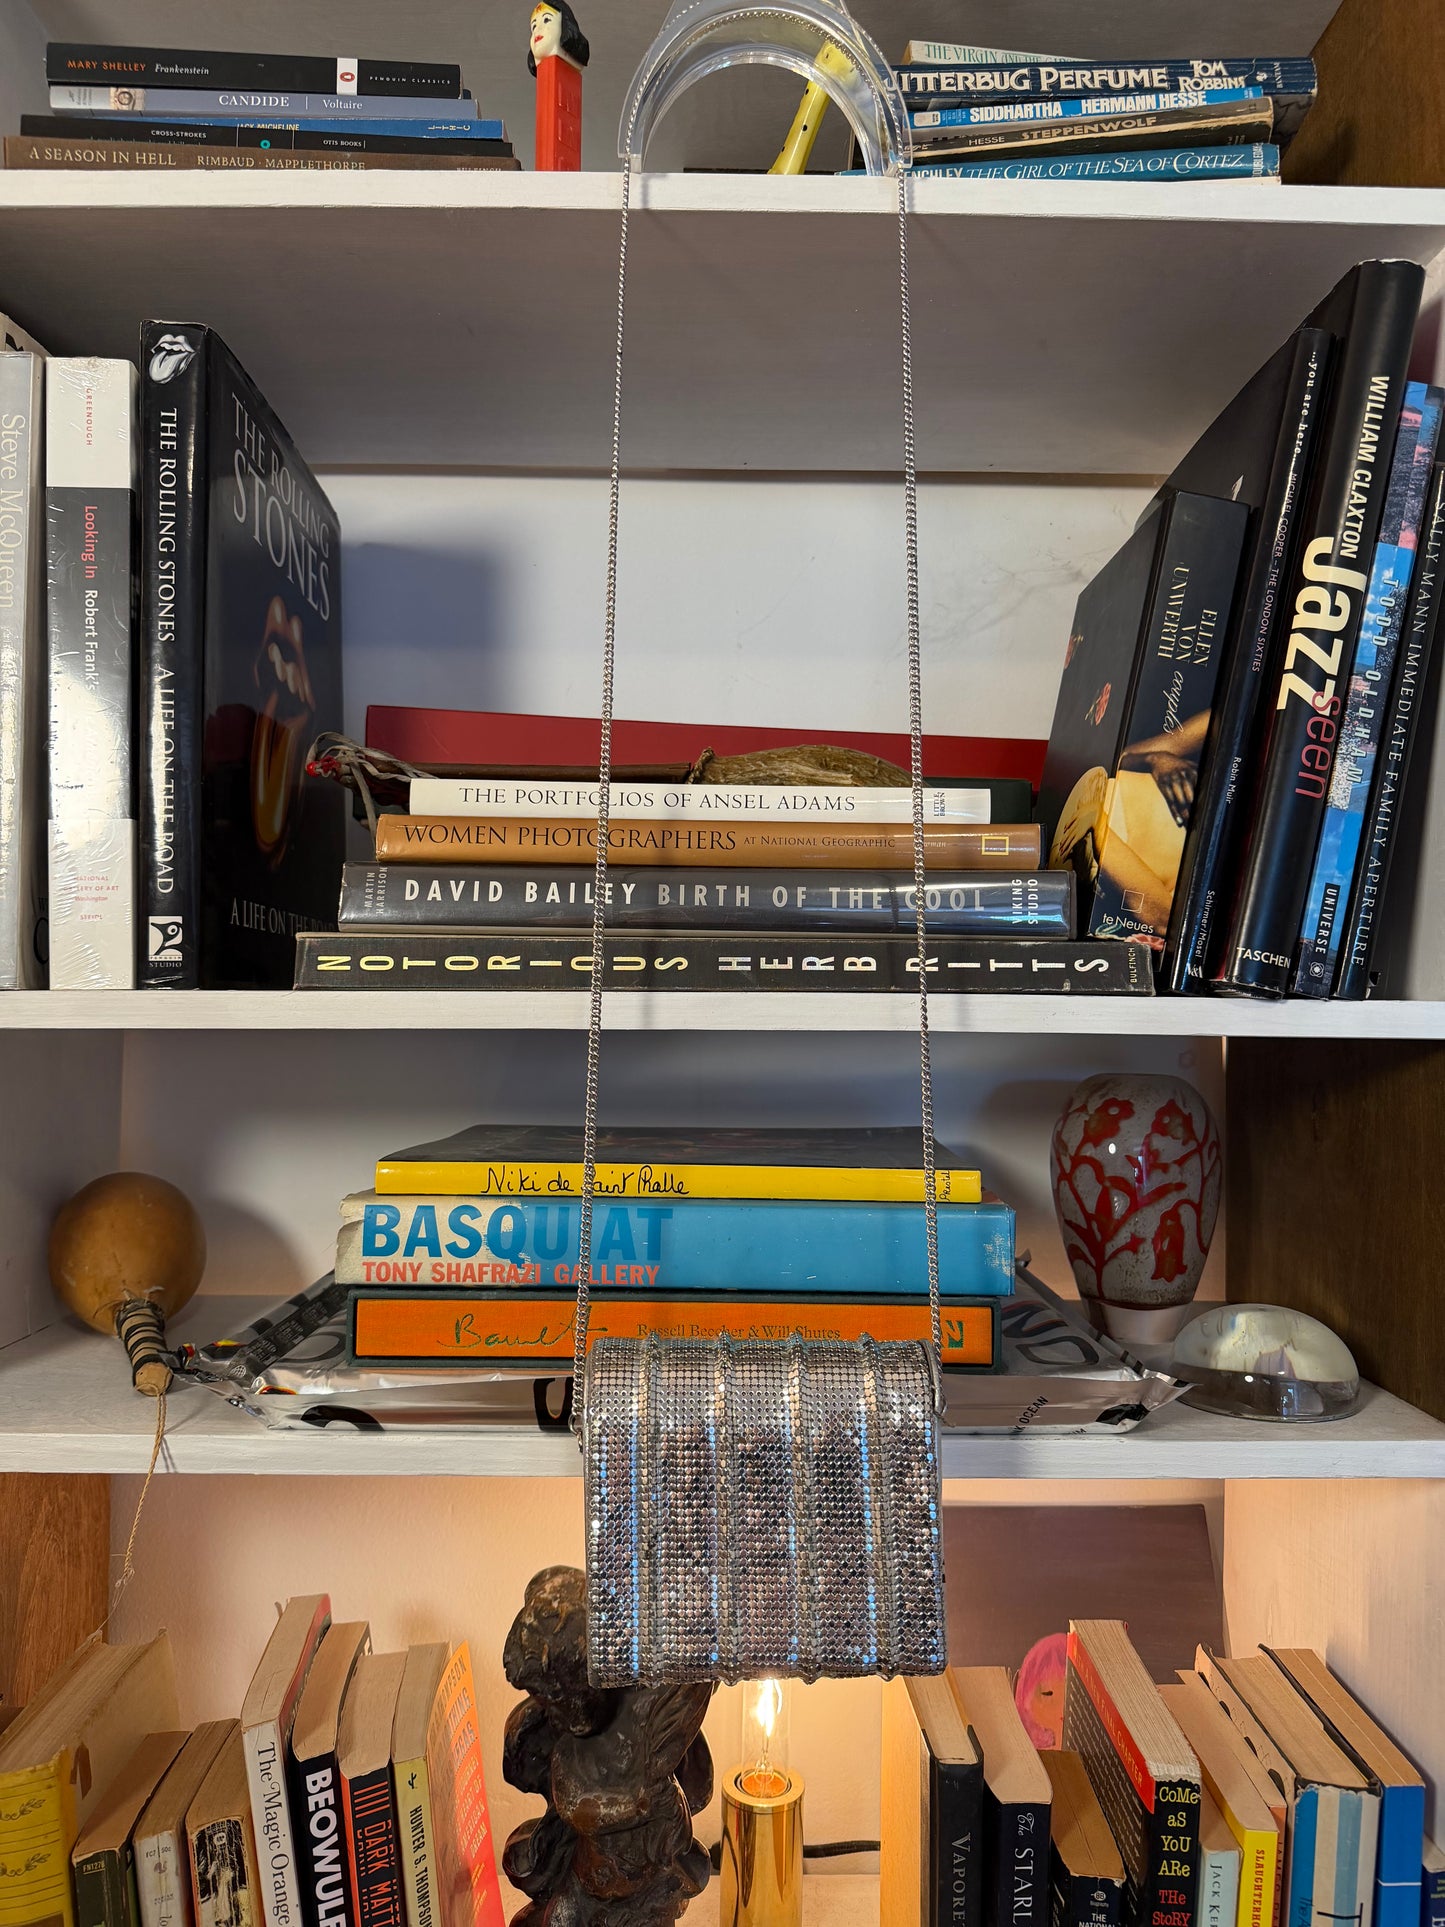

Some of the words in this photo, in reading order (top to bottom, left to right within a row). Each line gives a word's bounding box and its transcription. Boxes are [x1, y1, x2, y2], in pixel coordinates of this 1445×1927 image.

[67, 59, 98, 70] MARY
[102, 61, 147, 72] SHELLEY
[154, 63, 210, 76] Frankenstein
[924, 43, 952, 60] THE
[954, 45, 998, 63] VIRGIN
[1189, 60, 1229, 78] TOM
[1039, 66, 1168, 91] PERFUME
[1177, 75, 1247, 93] ROBBINS
[218, 94, 290, 108] CANDIDE
[322, 98, 363, 110] Voltaire
[970, 101, 1063, 123] SIDDHARTHA
[1081, 94, 1157, 114] HERMANN
[1158, 91, 1207, 110] HESSE
[151, 129, 207, 139] CROSS-STROKES
[969, 135, 1005, 146] HESSE
[1021, 117, 1157, 140] STEPPENWOLF
[29, 147, 41, 161] A
[43, 148, 108, 163] SEASON
[112, 151, 130, 164] IN
[134, 151, 177, 166] HELL
[197, 154, 256, 168] RIMBAUD
[265, 157, 366, 171] MAPPLETHORPE
[1004, 163, 1047, 179] GIRL
[1048, 162, 1072, 177] OF
[1072, 160, 1110, 177] THE
[1112, 156, 1150, 174] SEA
[1150, 157, 1173, 172] OF
[1173, 152, 1245, 174] CORTEZ
[85, 388, 94, 446] GREENOUGH
[1301, 393, 1312, 416] are
[1358, 375, 1390, 463] WILLIAM
[1, 413, 26, 480] Steve
[160, 407, 177, 450] THE
[231, 391, 266, 474] THE
[270, 449, 330, 559] ROLLING
[159, 457, 177, 553] ROLLING
[1340, 469, 1373, 560] CLAXTON
[0, 488, 24, 608] McQueen
[81, 506, 98, 563] Looking
[233, 448, 330, 622] STONES
[1273, 518, 1289, 558] COOPER
[85, 563, 96, 579] In
[1268, 568, 1279, 587] THE
[84, 590, 98, 638] Robert
[157, 559, 176, 643] STONES
[1157, 566, 1190, 660] UNWERTH
[1259, 589, 1274, 635] LONDON
[1372, 578, 1399, 648] TODD
[1412, 571, 1436, 634] MANN
[1175, 624, 1197, 664] VON
[1192, 609, 1218, 667] ELLEN
[1251, 637, 1266, 672] SIXTIES
[84, 640, 99, 691] Frank's
[156, 666, 175, 680] A
[1162, 670, 1185, 735] couples
[1388, 645, 1423, 763] IMMEDIATE
[1345, 670, 1382, 785] OLDHAM
[1229, 756, 1242, 781] Robin
[459, 787, 506, 804] THE
[515, 789, 654, 808] PORTFOLIOS
[663, 791, 691, 808] OF
[699, 791, 770, 810] ANSEL
[777, 794, 856, 811] ADAMS
[1225, 782, 1237, 804] Muir
[1372, 770, 1398, 848] FAMILY
[404, 824, 507, 846] WOMEN
[518, 826, 736, 850] PHOTOGRAPHERS
[743, 838, 759, 846] AT
[760, 836, 818, 847] NATIONAL
[821, 836, 896, 848] GEOGRAPHIC
[156, 829, 175, 894] ROAD
[364, 872, 376, 908] MARTIN
[375, 867, 388, 914] HARRISON
[404, 879, 504, 902] DAVID
[525, 881, 637, 906] BAILEY
[658, 884, 750, 906] BIRTH
[772, 886, 808, 908] OF
[829, 887, 883, 910] THE
[904, 888, 985, 911] COOL
[1012, 879, 1023, 924] VIKING
[1027, 878, 1039, 925] STUDIO
[243, 900, 267, 932] LIFE
[268, 907, 286, 935] ON
[1115, 914, 1154, 934] Neues
[1195, 890, 1216, 958] Schirmer/Mosel
[1315, 887, 1337, 955] UNIVERSE
[1350, 856, 1383, 967] APERTURE
[317, 954, 689, 972] NOTORIOUS
[718, 955, 877, 973] HERB
[905, 956, 1110, 974] RITTS
[1236, 947, 1291, 969] TASCHEN
[481, 1165, 541, 1194] Niki
[547, 1171, 574, 1193] de
[637, 1165, 690, 1195] Phalle
[361, 1203, 673, 1270] BASQUAT
[362, 1262, 423, 1282] TONY
[431, 1262, 541, 1285] SHAFRAZI
[553, 1264, 660, 1286] GALLERY
[748, 1325, 760, 1338] &
[762, 1326, 790, 1338] Will
[1018, 1395, 1049, 1424] OCEAN
[257, 1742, 278, 1783] The
[1116, 1730, 1143, 1788] CHAPTER
[263, 1780, 286, 1852] Magic
[409, 1804, 425, 1854] HUNTER
[363, 1820, 390, 1875] DARK
[413, 1854, 427, 1869] S.
[270, 1853, 292, 1925] Orange
[1209, 1863, 1223, 1898] JACK
[1091, 1913, 1107, 1923] THE
